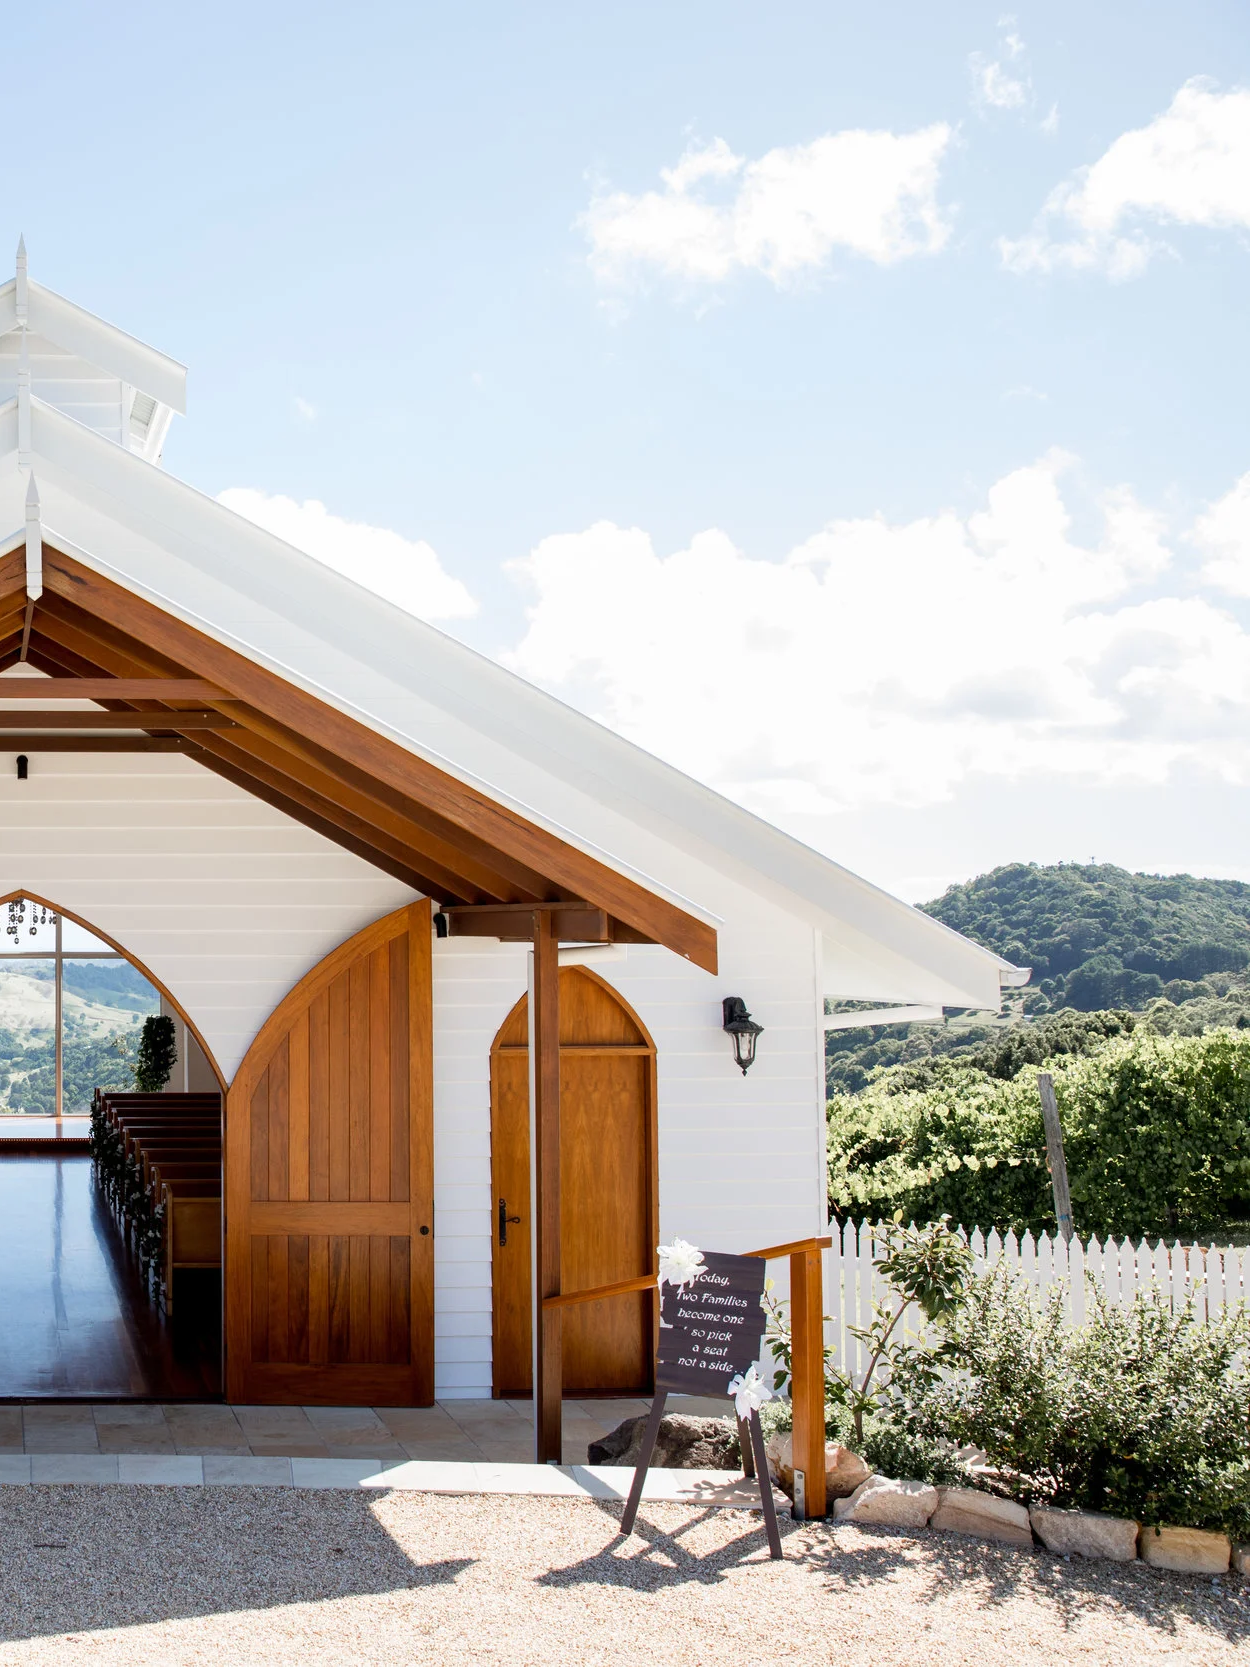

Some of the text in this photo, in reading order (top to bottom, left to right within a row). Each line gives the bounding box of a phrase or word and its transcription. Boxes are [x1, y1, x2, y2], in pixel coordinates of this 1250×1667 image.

[701, 1292, 748, 1308] Families
[677, 1307, 745, 1325] become one
[690, 1328, 733, 1341] so pick
[691, 1344, 728, 1357] a seat
[677, 1357, 698, 1367] not
[699, 1360, 707, 1369] a
